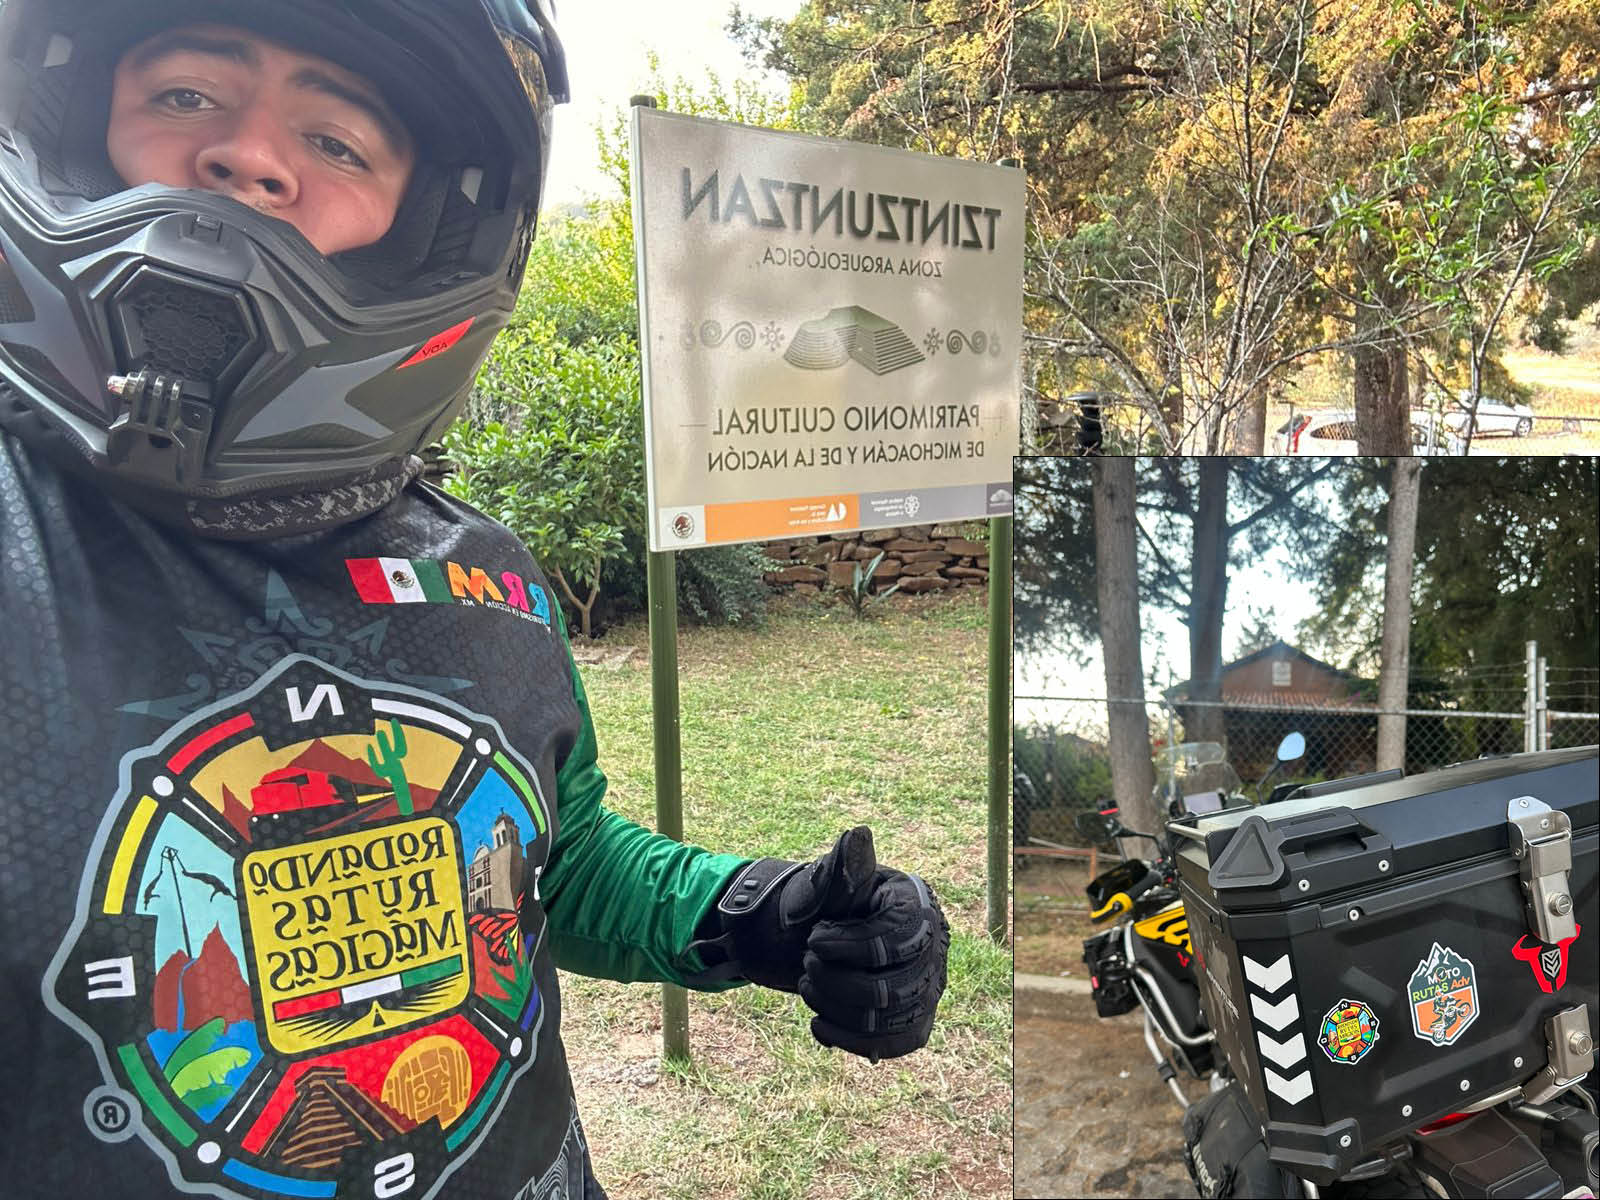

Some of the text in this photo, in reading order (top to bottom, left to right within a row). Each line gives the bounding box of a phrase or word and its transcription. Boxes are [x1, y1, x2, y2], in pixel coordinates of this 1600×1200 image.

[1428, 967, 1460, 985] MOTO
[1412, 976, 1470, 1001] RUTAS Adv
